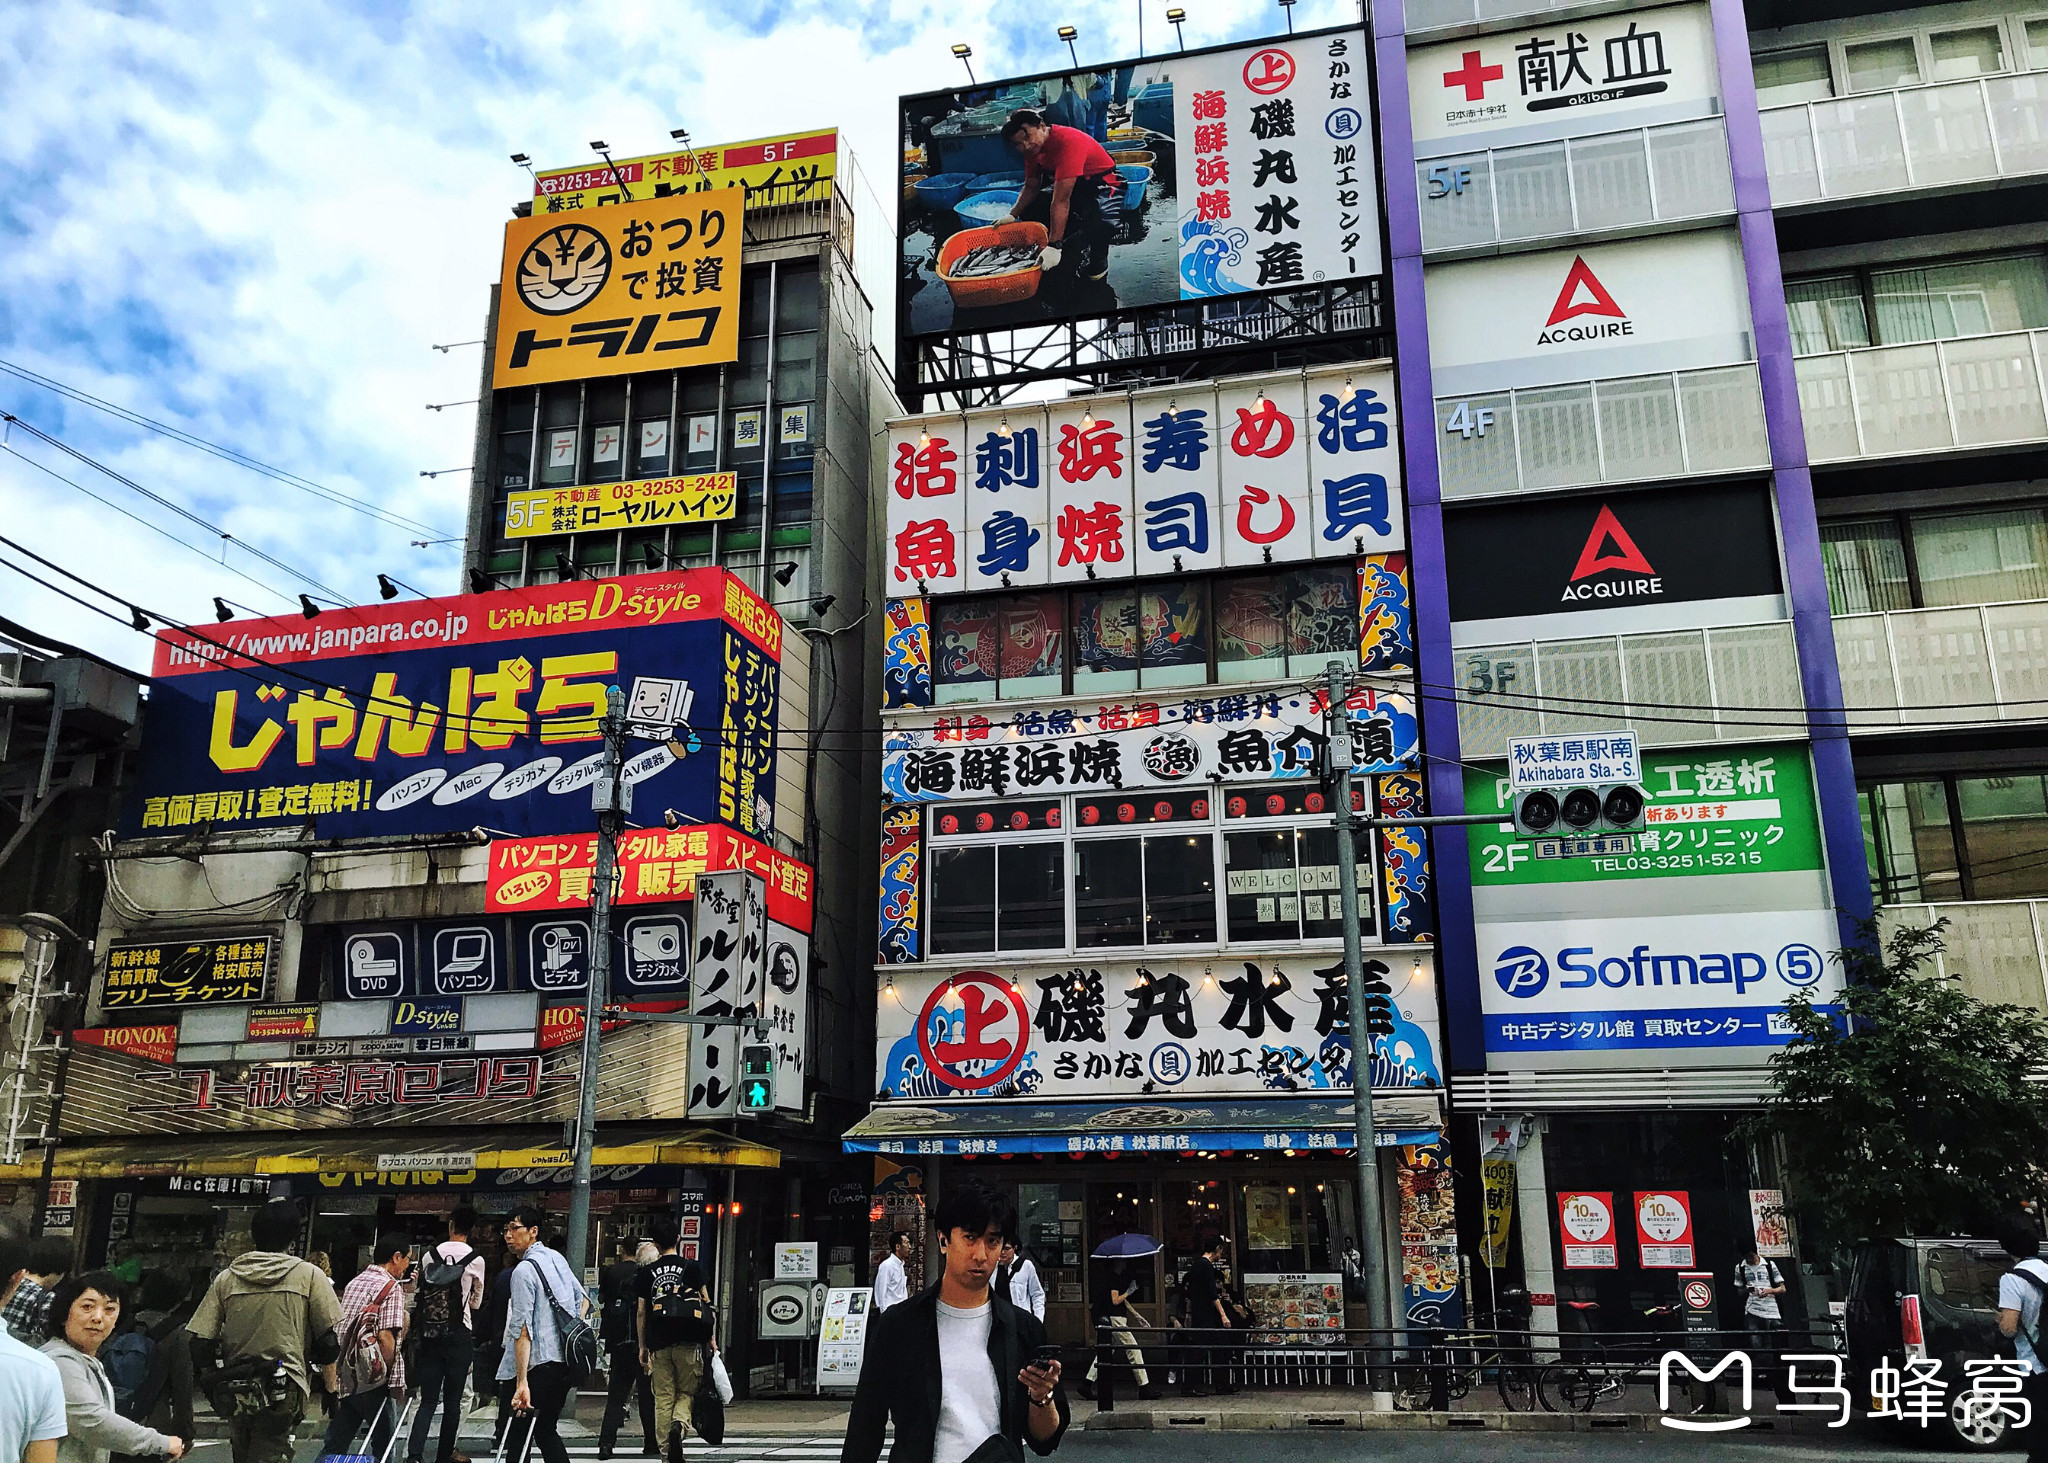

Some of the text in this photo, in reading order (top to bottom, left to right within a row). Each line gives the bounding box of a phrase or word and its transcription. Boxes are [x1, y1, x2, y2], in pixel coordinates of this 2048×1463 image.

[1328, 38, 1352, 100] さかな
[1515, 22, 1672, 96] 献血
[1446, 104, 1507, 121] 日本赤十字社
[649, 151, 719, 181] 不動産
[1192, 90, 1232, 222] 海鮮浜焼
[1250, 98, 1305, 287] 磯丸水産
[1428, 164, 1471, 199] 5F
[1333, 144, 1361, 275] 加工センター
[620, 208, 725, 260] おつり
[622, 255, 723, 300] で投資
[509, 306, 722, 369] トラノコ
[1536, 321, 1634, 346] ACQUIRE
[1446, 402, 1494, 439] 4F
[1231, 399, 1296, 545] めし
[1317, 388, 1392, 542] 活貝
[553, 487, 601, 504] 不動産
[612, 474, 736, 500] 03-3253-2421
[1057, 419, 1125, 569] 浜焼
[1142, 408, 1209, 554] 寿司
[507, 498, 549, 529] 5F
[552, 493, 734, 526] 株式 ローヤルハイツ
[894, 437, 957, 583] 活魚
[974, 427, 1040, 577] 刺身
[551, 518, 577, 532] 会社
[1561, 577, 1663, 602] ACQUIRE
[488, 600, 587, 631] じゃんぱら
[723, 578, 781, 653] 最短3分
[169, 611, 468, 667] http://www.janpara.co.jp
[1467, 654, 1516, 695] 3F
[208, 650, 619, 774] じゃんぱら
[759, 663, 775, 776] パソコン
[720, 632, 741, 823] じゃんぱら
[740, 649, 760, 833] デジタル家電
[623, 750, 665, 780] AV機器
[905, 740, 1123, 793] 海鮮浜焼
[1514, 738, 1633, 765] 秋葉原駅南
[454, 773, 482, 794] Mac
[504, 763, 548, 792] デジカメ
[555, 759, 604, 791] デジタル家
[1519, 761, 1636, 782] Akihabara Sta.-S.
[391, 776, 432, 803] パソコン
[499, 843, 578, 869] パソコン
[1482, 844, 1530, 872] 2F
[1543, 839, 1625, 857] 自転車専用
[1591, 851, 1762, 873] TEL03-3251-5215
[725, 835, 808, 902] スピード査定
[500, 874, 549, 902] いろいろ
[700, 878, 740, 924] 喫茶室
[111, 949, 161, 967] 新幹線
[215, 942, 266, 962] 各種金券
[562, 939, 578, 950] DV
[107, 968, 159, 987] 高価買取
[212, 961, 264, 980] 格安販売
[360, 977, 388, 991] DVD
[441, 973, 489, 990] パソコン
[543, 968, 581, 984] ビデオ
[635, 962, 681, 979] デジカメ
[1556, 944, 1767, 995] Sofmap
[106, 982, 259, 1005] フリーチケット
[395, 1002, 459, 1030] D-Style
[935, 959, 1396, 1064] 上 磯丸水産
[1502, 1015, 1762, 1041] 中古デジタル館 買取センター
[1053, 1049, 1145, 1082] さかな
[878, 1140, 904, 1154] 寿司
[958, 1139, 998, 1154] 浜焼き
[1067, 1136, 1126, 1151] 磯丸水産
[1131, 1134, 1191, 1150] 秋葉原店
[1307, 1133, 1338, 1148] 活魚
[681, 1192, 704, 1201] スマホ
[683, 1203, 700, 1213] PC
[1573, 1204, 1589, 1217] 10
[1649, 1203, 1666, 1217] 10
